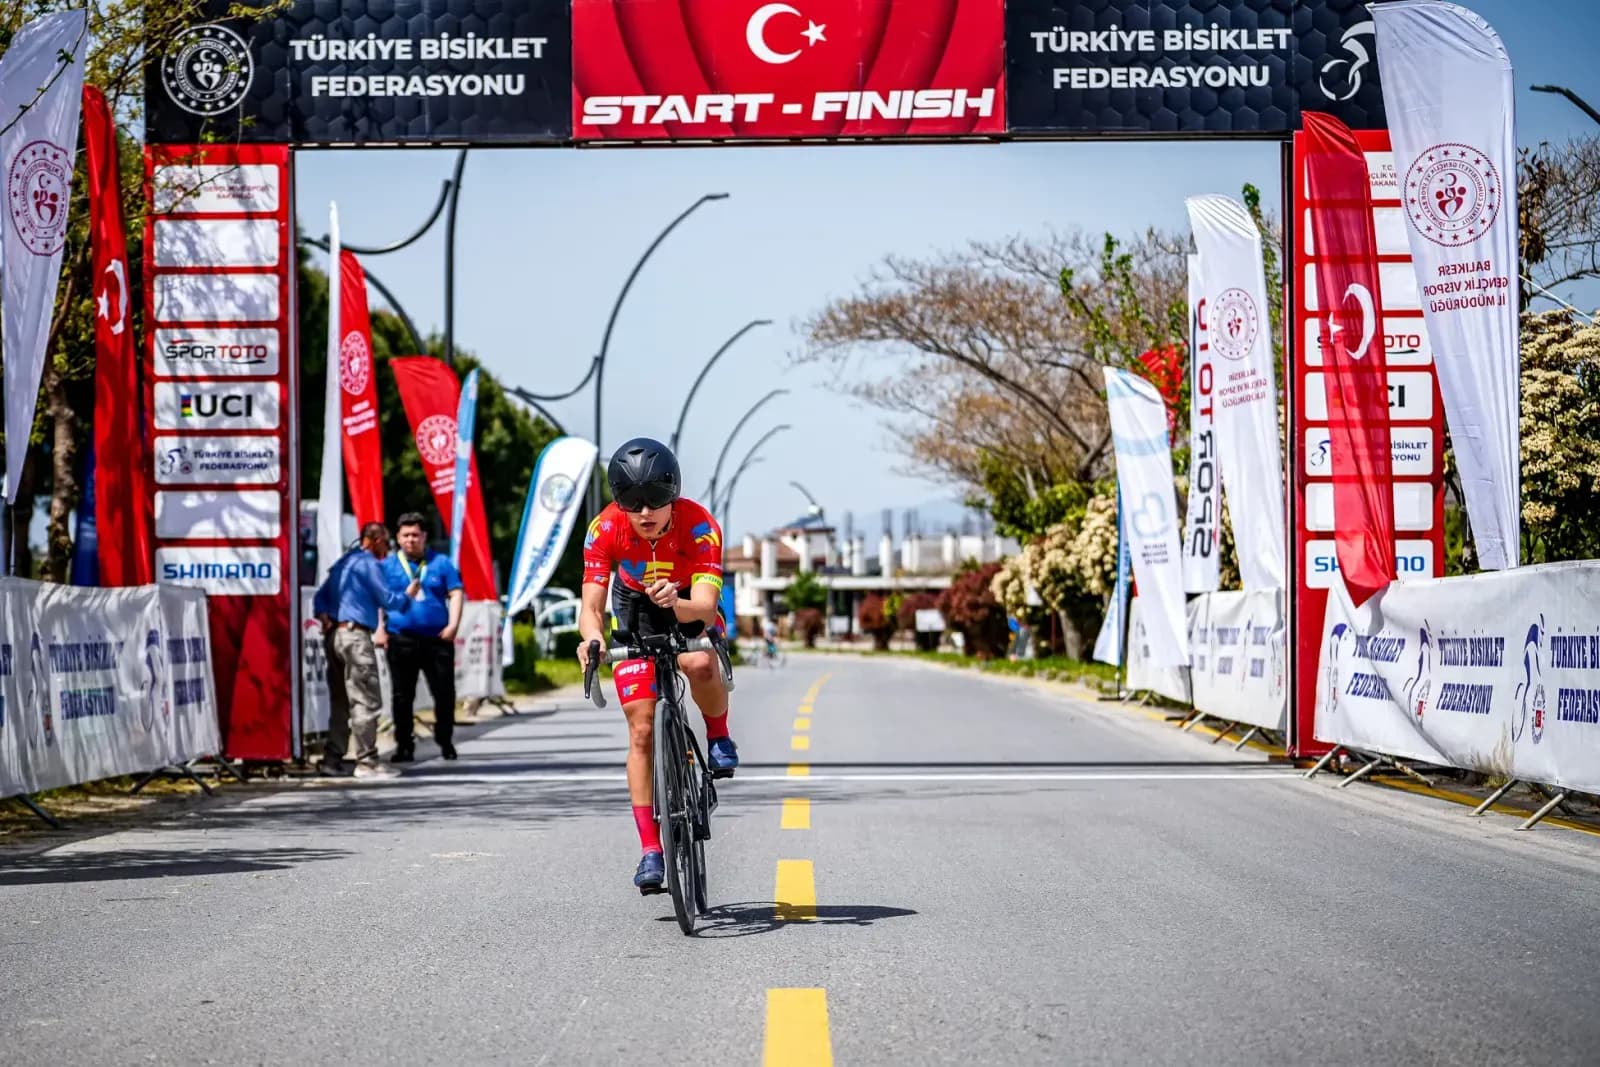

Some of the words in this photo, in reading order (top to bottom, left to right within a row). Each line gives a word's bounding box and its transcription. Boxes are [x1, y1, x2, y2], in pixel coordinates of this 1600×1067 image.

[290, 35, 414, 61] TÜRKİYE
[419, 32, 548, 60] BİSİKLET
[1031, 26, 1155, 53] TÜRKİYE
[1164, 23, 1292, 51] BİSİKLET
[312, 74, 525, 97] FEDERASYONU
[1053, 65, 1270, 89] FEDERASYONU
[582, 93, 774, 125] START
[811, 88, 995, 121] FINISH
[166, 346, 267, 359] SPORTOTO
[194, 394, 252, 417] UCI
[199, 462, 269, 471] FEDERASYONU
[163, 563, 272, 580] SHIMANO
[1437, 630, 1468, 667] TÜRKİYE
[1469, 629, 1505, 667] BİSİKLET
[1551, 626, 1588, 669] TÜRKİYE
[1435, 682, 1494, 715] FEDERASYONU
